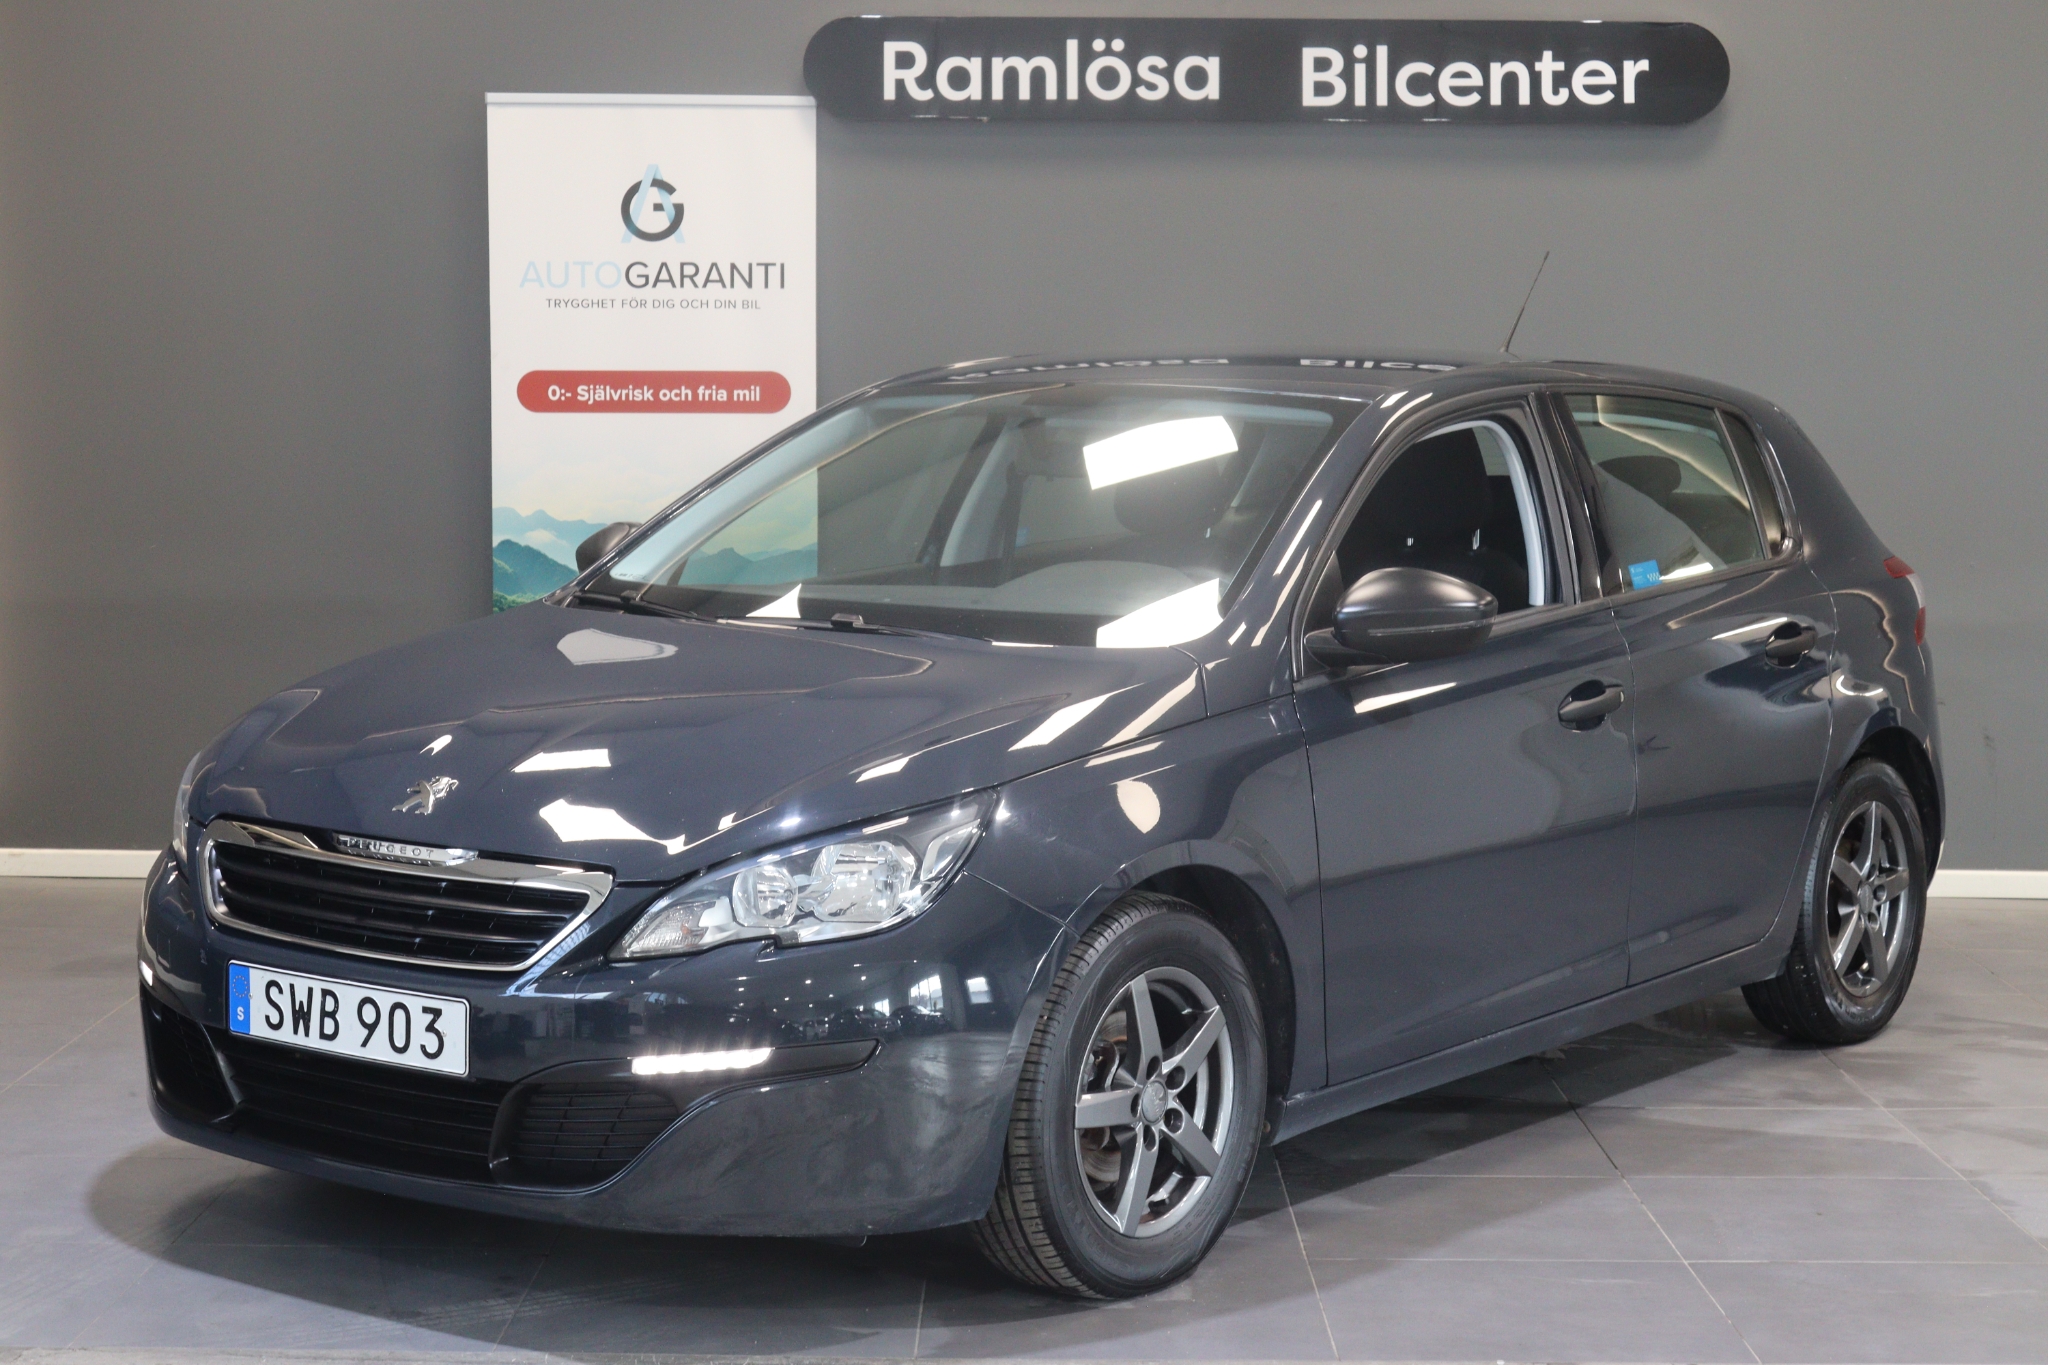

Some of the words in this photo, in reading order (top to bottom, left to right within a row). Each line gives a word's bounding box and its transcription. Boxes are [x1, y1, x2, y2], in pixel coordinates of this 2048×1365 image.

[883, 38, 1220, 102] Ramlösa
[1301, 43, 1650, 107] Bilcenter
[519, 261, 786, 290] AUTOGARANTI
[546, 298, 616, 309] TRYGGHET
[621, 296, 648, 309] FÖR
[652, 299, 676, 309] DIG
[680, 299, 709, 309] OCH
[714, 299, 737, 309] DIN
[741, 299, 761, 310] BIL
[576, 384, 654, 405] Självrisk
[658, 385, 692, 402] och
[697, 384, 728, 402] fria
[733, 384, 760, 402] mil
[347, 837, 435, 859] PEUGEOT
[236, 1006, 245, 1021] S
[264, 979, 340, 1042] SWB
[357, 996, 446, 1060] 903
